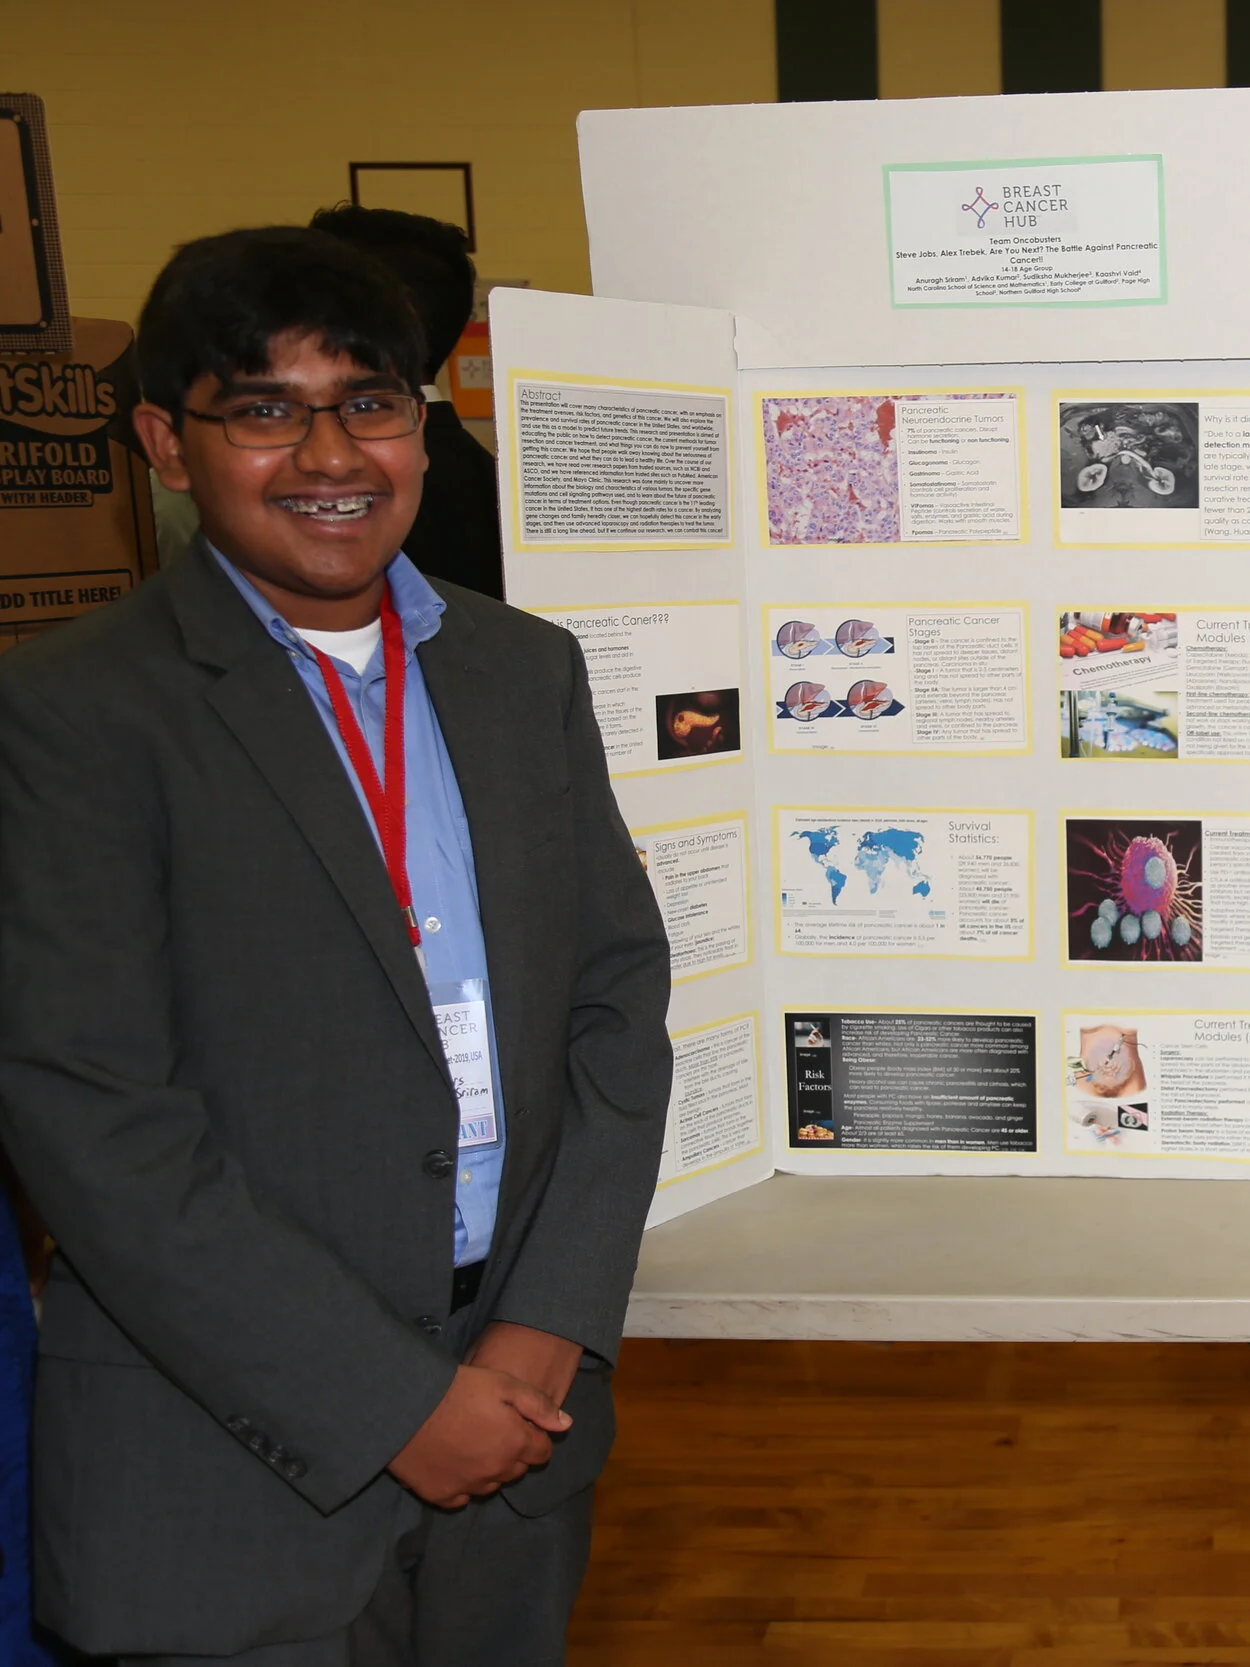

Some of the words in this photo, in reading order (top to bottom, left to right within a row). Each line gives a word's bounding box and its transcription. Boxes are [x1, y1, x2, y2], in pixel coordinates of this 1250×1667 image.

[1003, 185, 1061, 198] BREAST
[1003, 199, 1068, 212] CANCER
[1004, 215, 1037, 228] HUB
[521, 389, 561, 401] Abstract
[902, 416, 972, 424] Neuroendocrine
[1204, 416, 1222, 424] Why
[52, 469, 110, 484] BOARD
[40, 492, 88, 503] HEADER
[29, 590, 74, 607] TITLE
[567, 616, 619, 629] Pancreatic
[622, 614, 669, 626] Caner???
[909, 617, 961, 626] Pancreatic
[964, 616, 1000, 624] Cancer
[1196, 620, 1240, 630] Current
[909, 628, 941, 638] Stages
[1197, 633, 1246, 643] Modules
[1073, 656, 1151, 675] Chemotherapy
[948, 821, 991, 831] Survival
[656, 841, 676, 853] Signs
[678, 837, 694, 848] and
[696, 831, 737, 845] Symptoms
[949, 834, 999, 843] Statistics:
[1194, 1019, 1236, 1029] Current
[1195, 1032, 1241, 1041] Modules
[471, 1051, 482, 1060] USA
[805, 1070, 824, 1078] Risk
[799, 1082, 832, 1091] Factors
